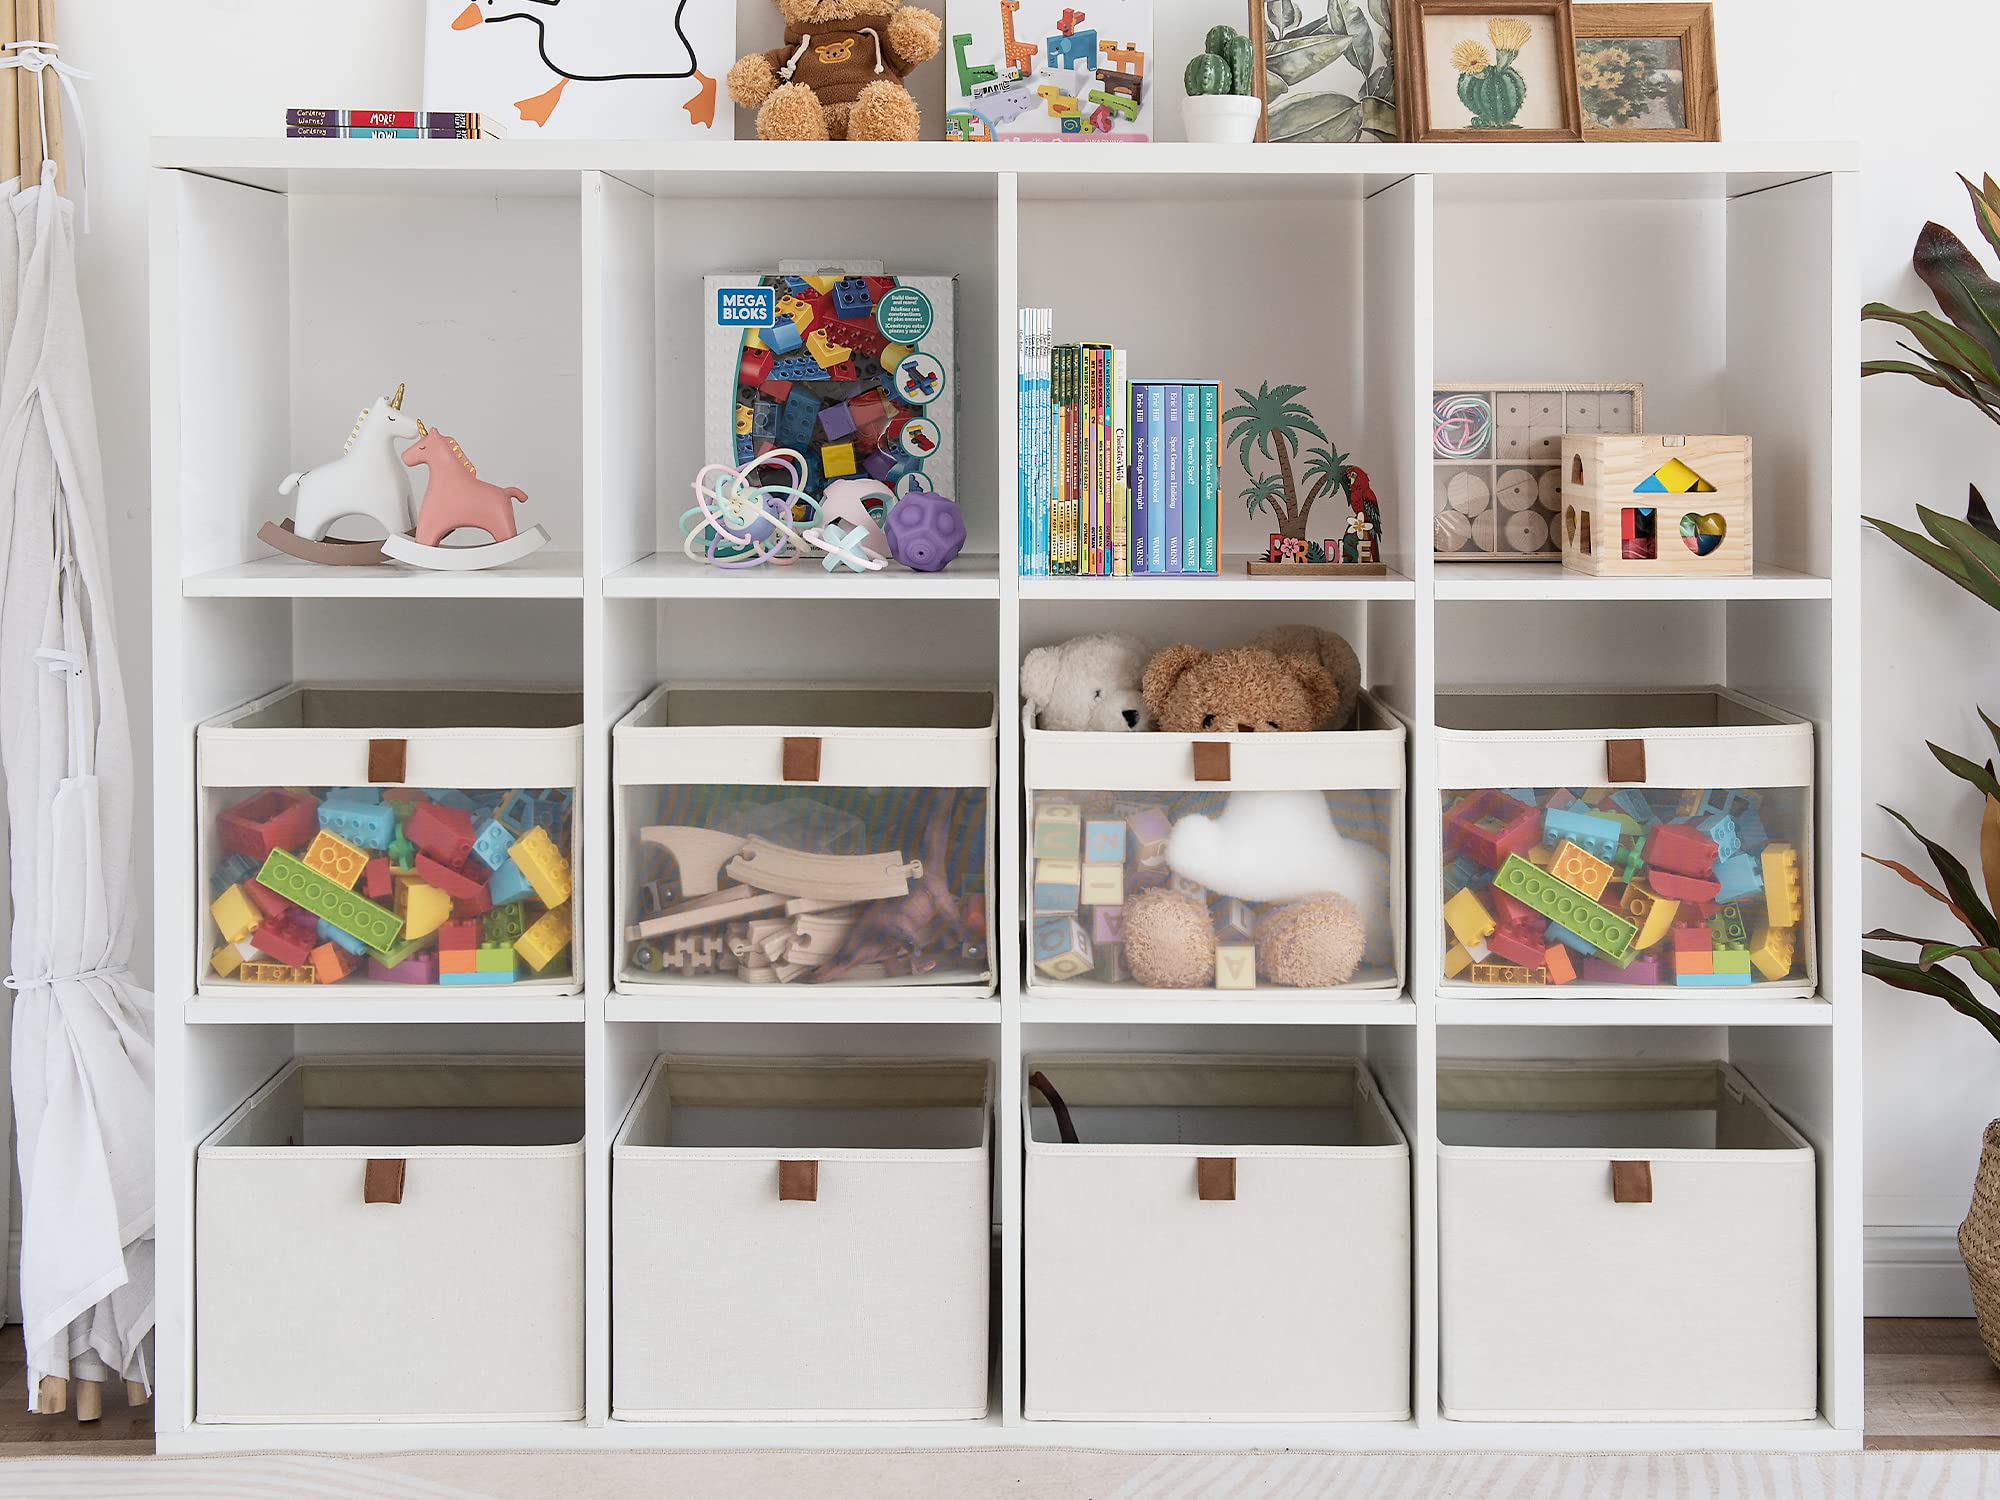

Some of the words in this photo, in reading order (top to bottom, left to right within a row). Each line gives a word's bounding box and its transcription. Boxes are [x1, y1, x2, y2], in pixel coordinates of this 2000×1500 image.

[370, 113, 396, 125] MORE!
[723, 294, 766, 306] MEGA
[723, 308, 767, 320] BLOKS
[1091, 360, 1095, 369] MY
[1098, 359, 1102, 368] MY
[1106, 359, 1110, 368] MY
[1136, 454, 1144, 474] Stays
[1116, 465, 1124, 481] Web
[1171, 472, 1175, 480] on
[1224, 956, 1246, 981] A
